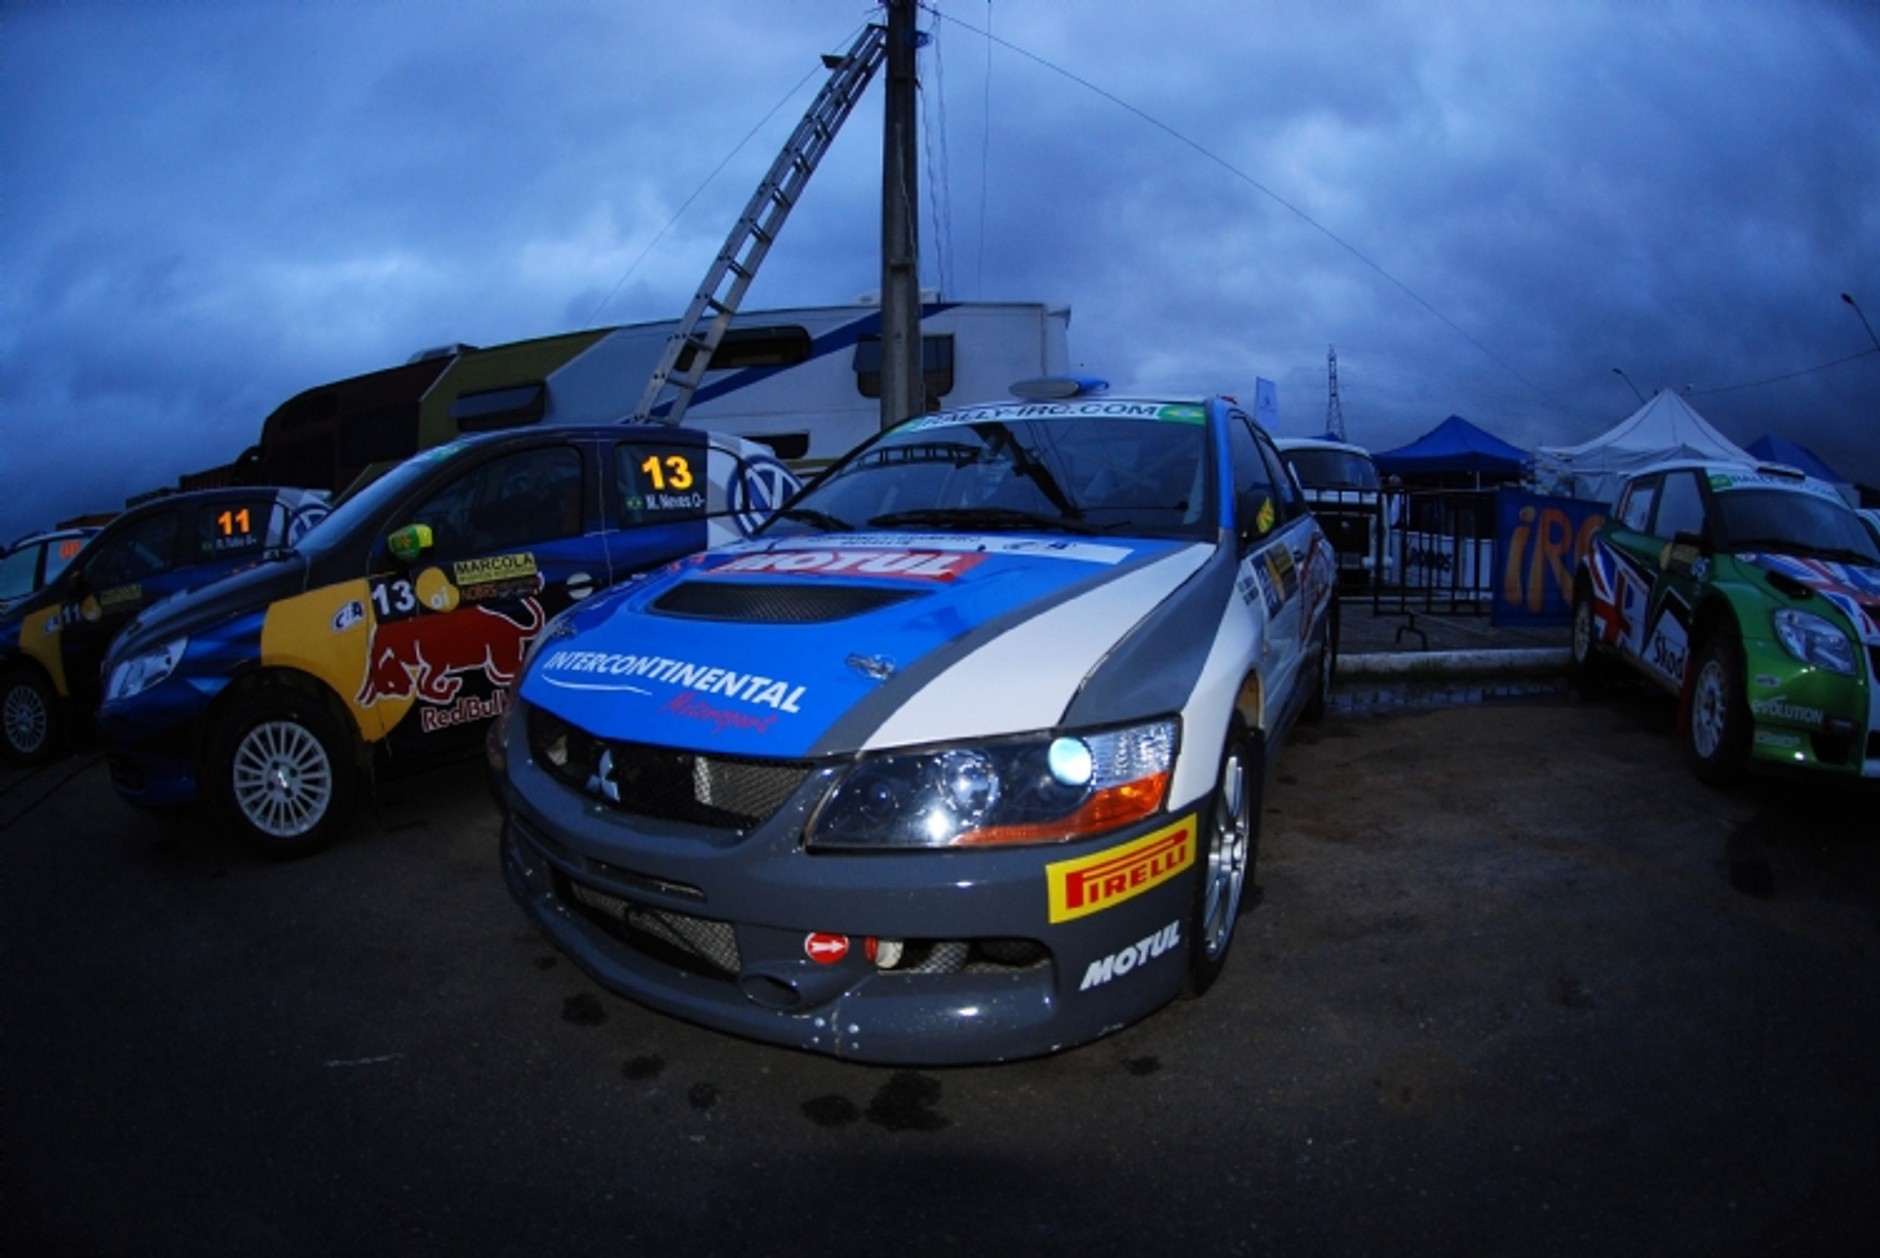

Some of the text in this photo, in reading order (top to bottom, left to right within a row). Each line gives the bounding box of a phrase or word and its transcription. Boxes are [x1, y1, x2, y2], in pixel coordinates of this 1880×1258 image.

[641, 455, 694, 491] 13
[217, 506, 251, 536] 11
[455, 552, 533, 574] MARCOLA
[706, 552, 963, 576] MOTUL
[62, 602, 82, 625] 11
[372, 579, 416, 616] 13
[430, 585, 449, 611] oi
[542, 651, 807, 714] INTERCONTINENTAL
[421, 696, 466, 733] Red
[1065, 829, 1188, 910] PIRELLI
[1078, 918, 1182, 992] MOTUL
